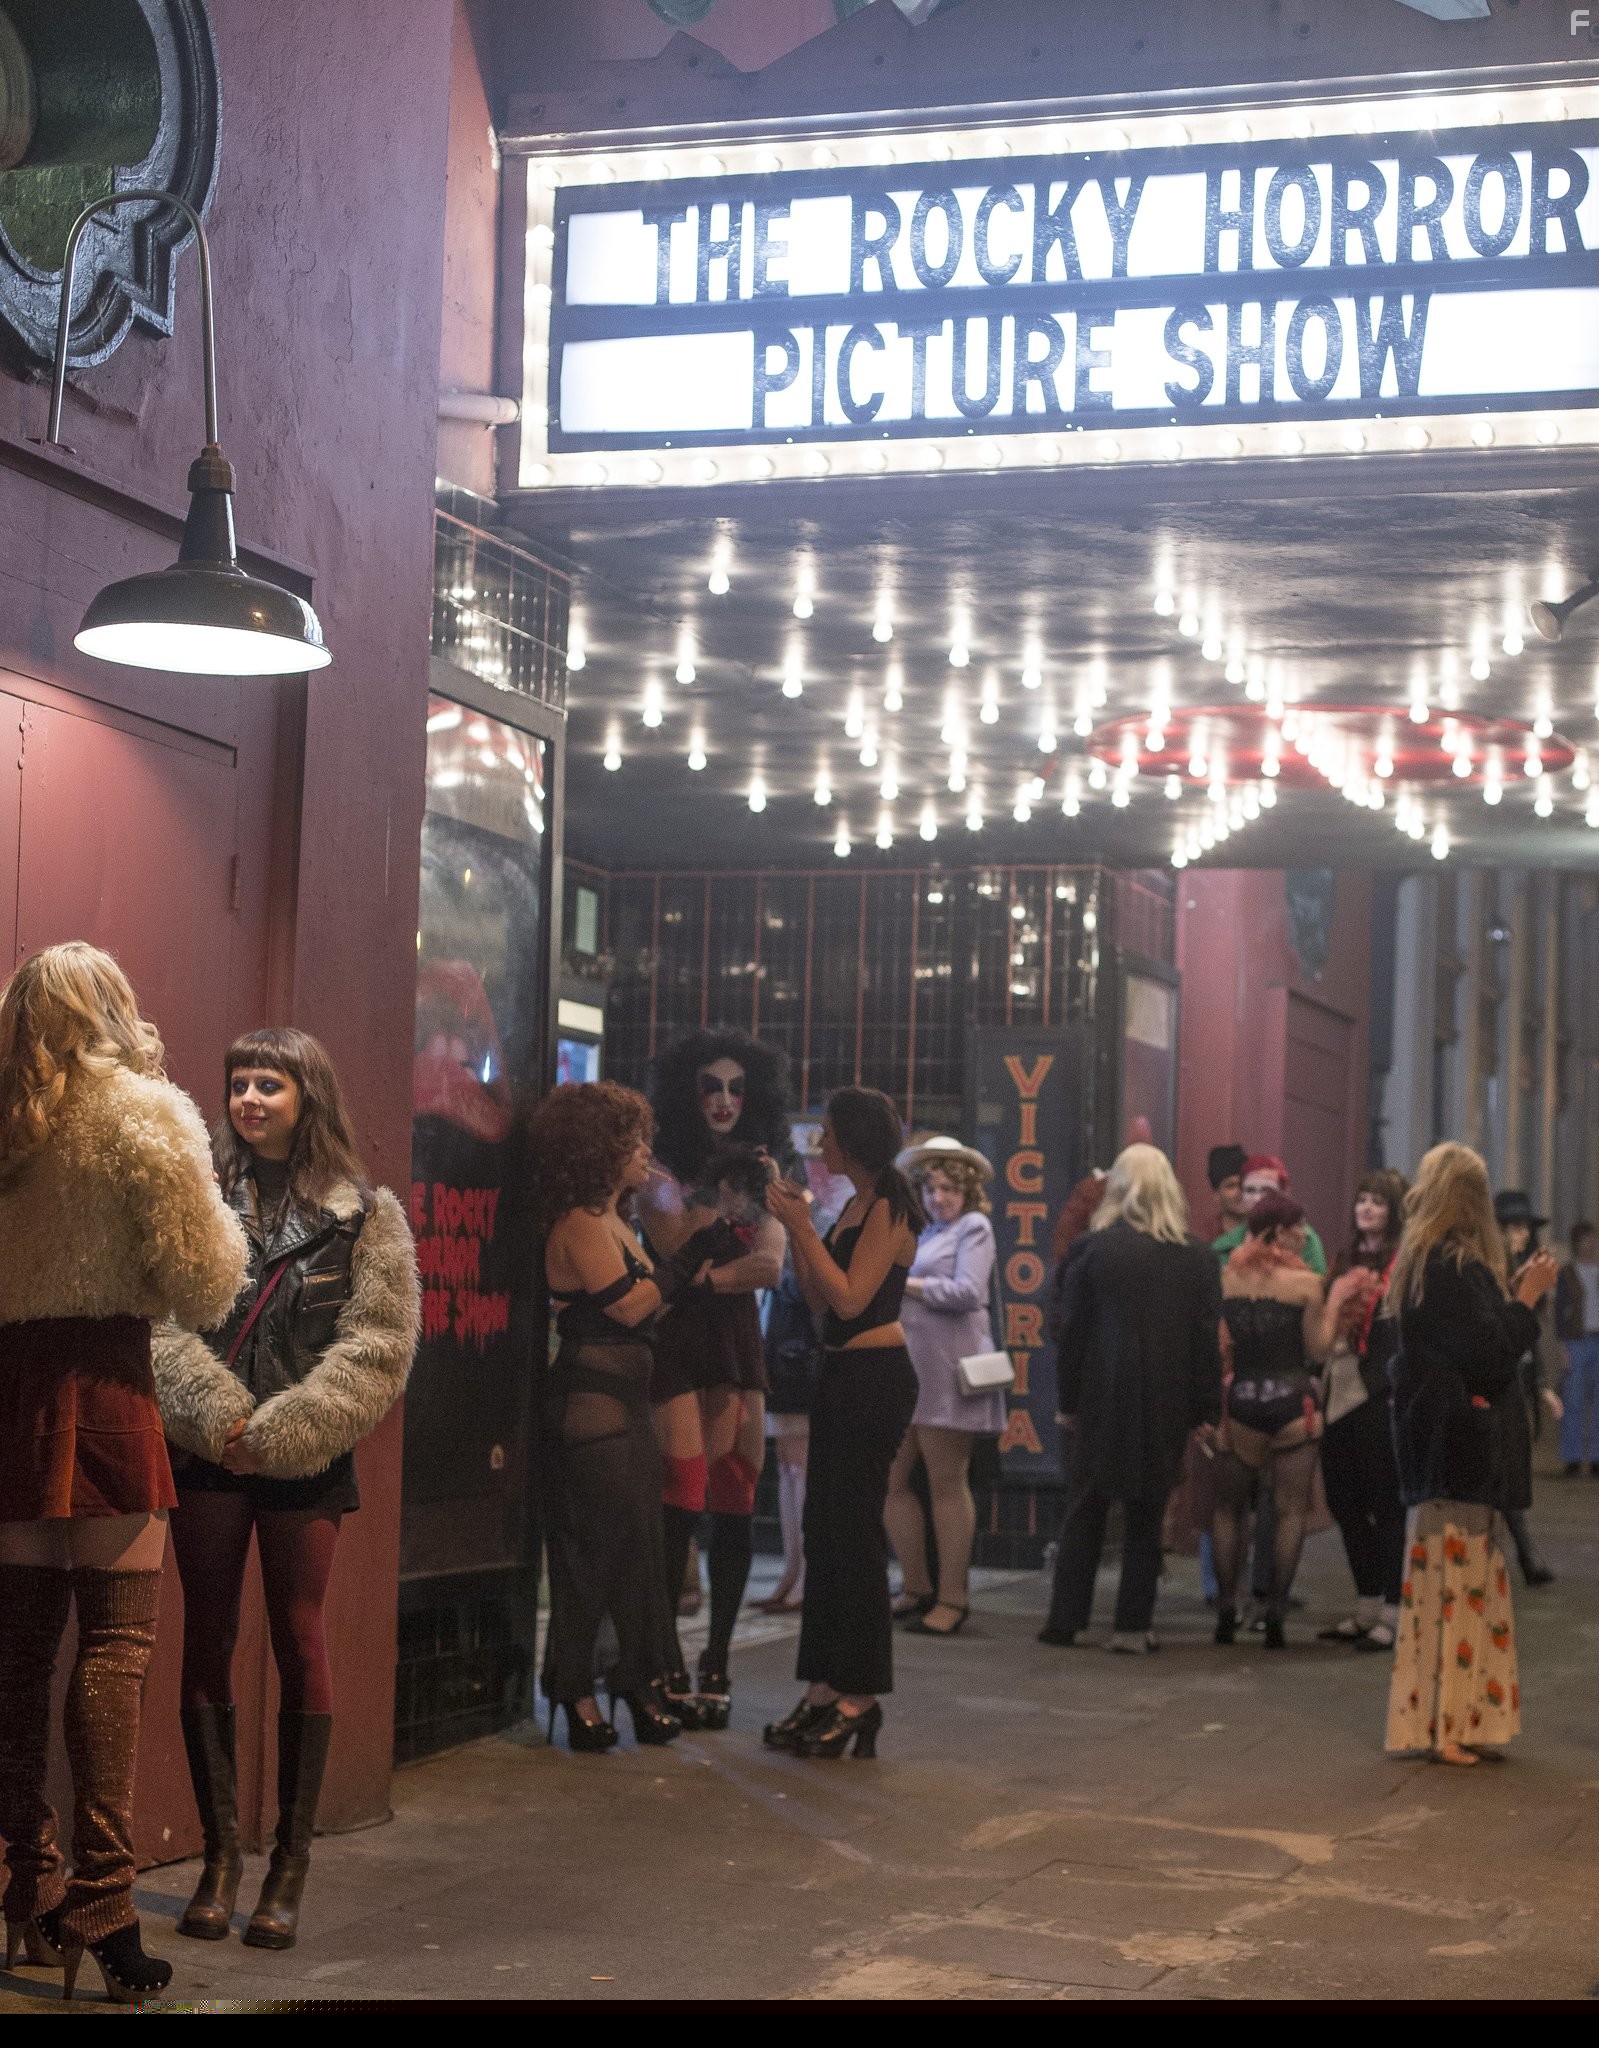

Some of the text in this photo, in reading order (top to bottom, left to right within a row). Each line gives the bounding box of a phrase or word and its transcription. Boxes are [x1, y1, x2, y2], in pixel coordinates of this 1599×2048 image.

[642, 147, 1590, 303] THE ROCKY HORROR
[752, 292, 1431, 429] PICTURE SHOW
[1000, 1055, 1054, 1454] VICTORIA
